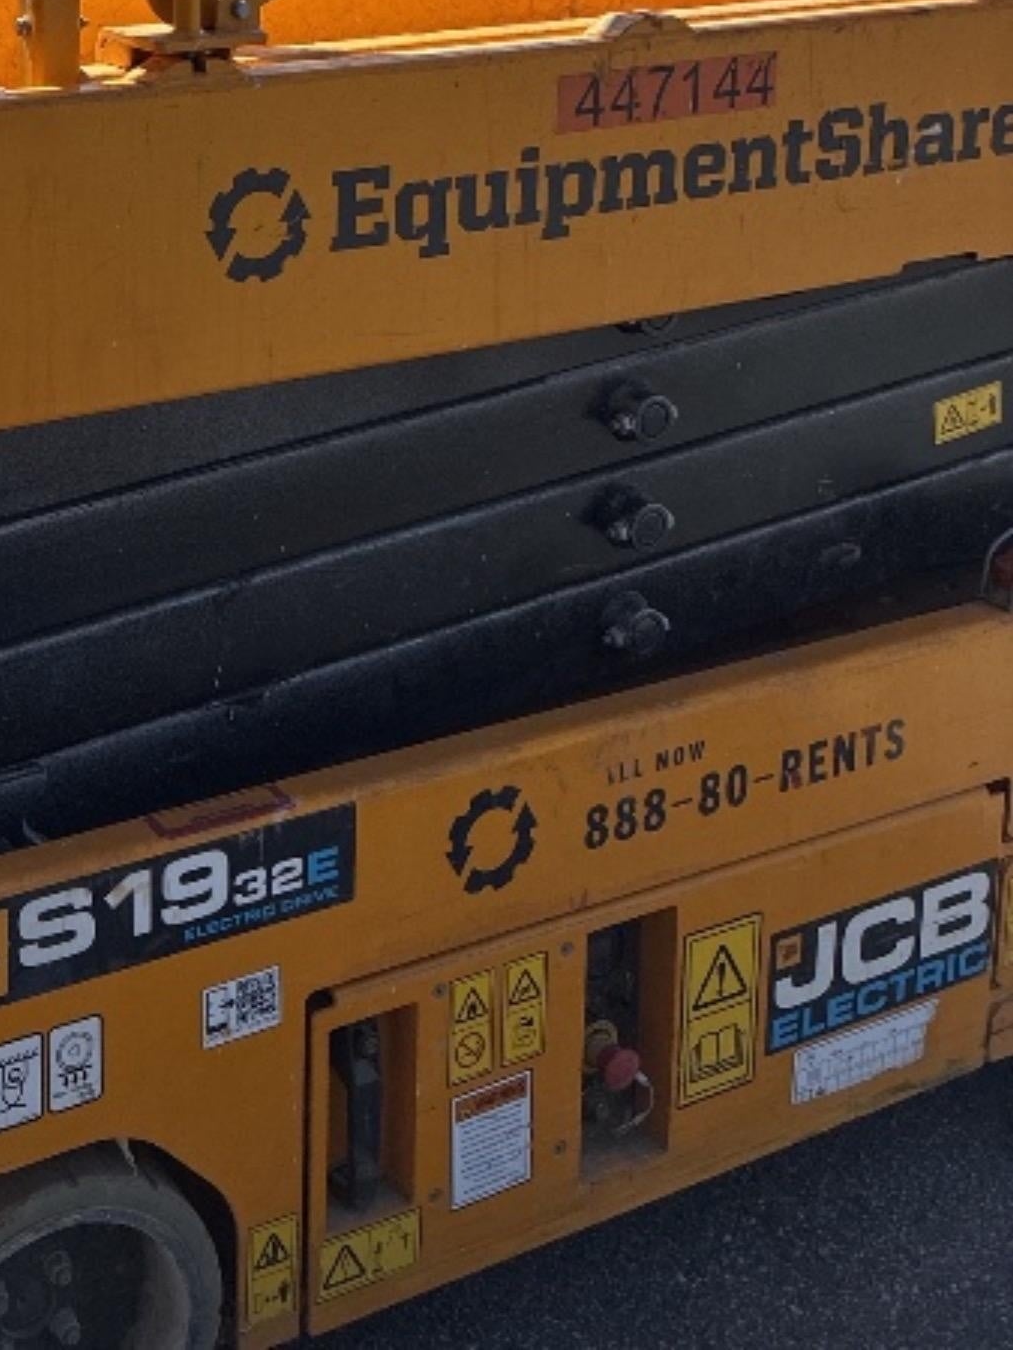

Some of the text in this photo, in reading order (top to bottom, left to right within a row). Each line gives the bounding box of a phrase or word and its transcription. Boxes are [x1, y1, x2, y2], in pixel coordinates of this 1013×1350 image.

[574, 51, 777, 127] 447144
[584, 718, 906, 850] 888-80-RENTS
[655, 740, 706, 772] NOW
[775, 871, 991, 1010] JCB
[770, 942, 991, 1049] ELECTRIC
